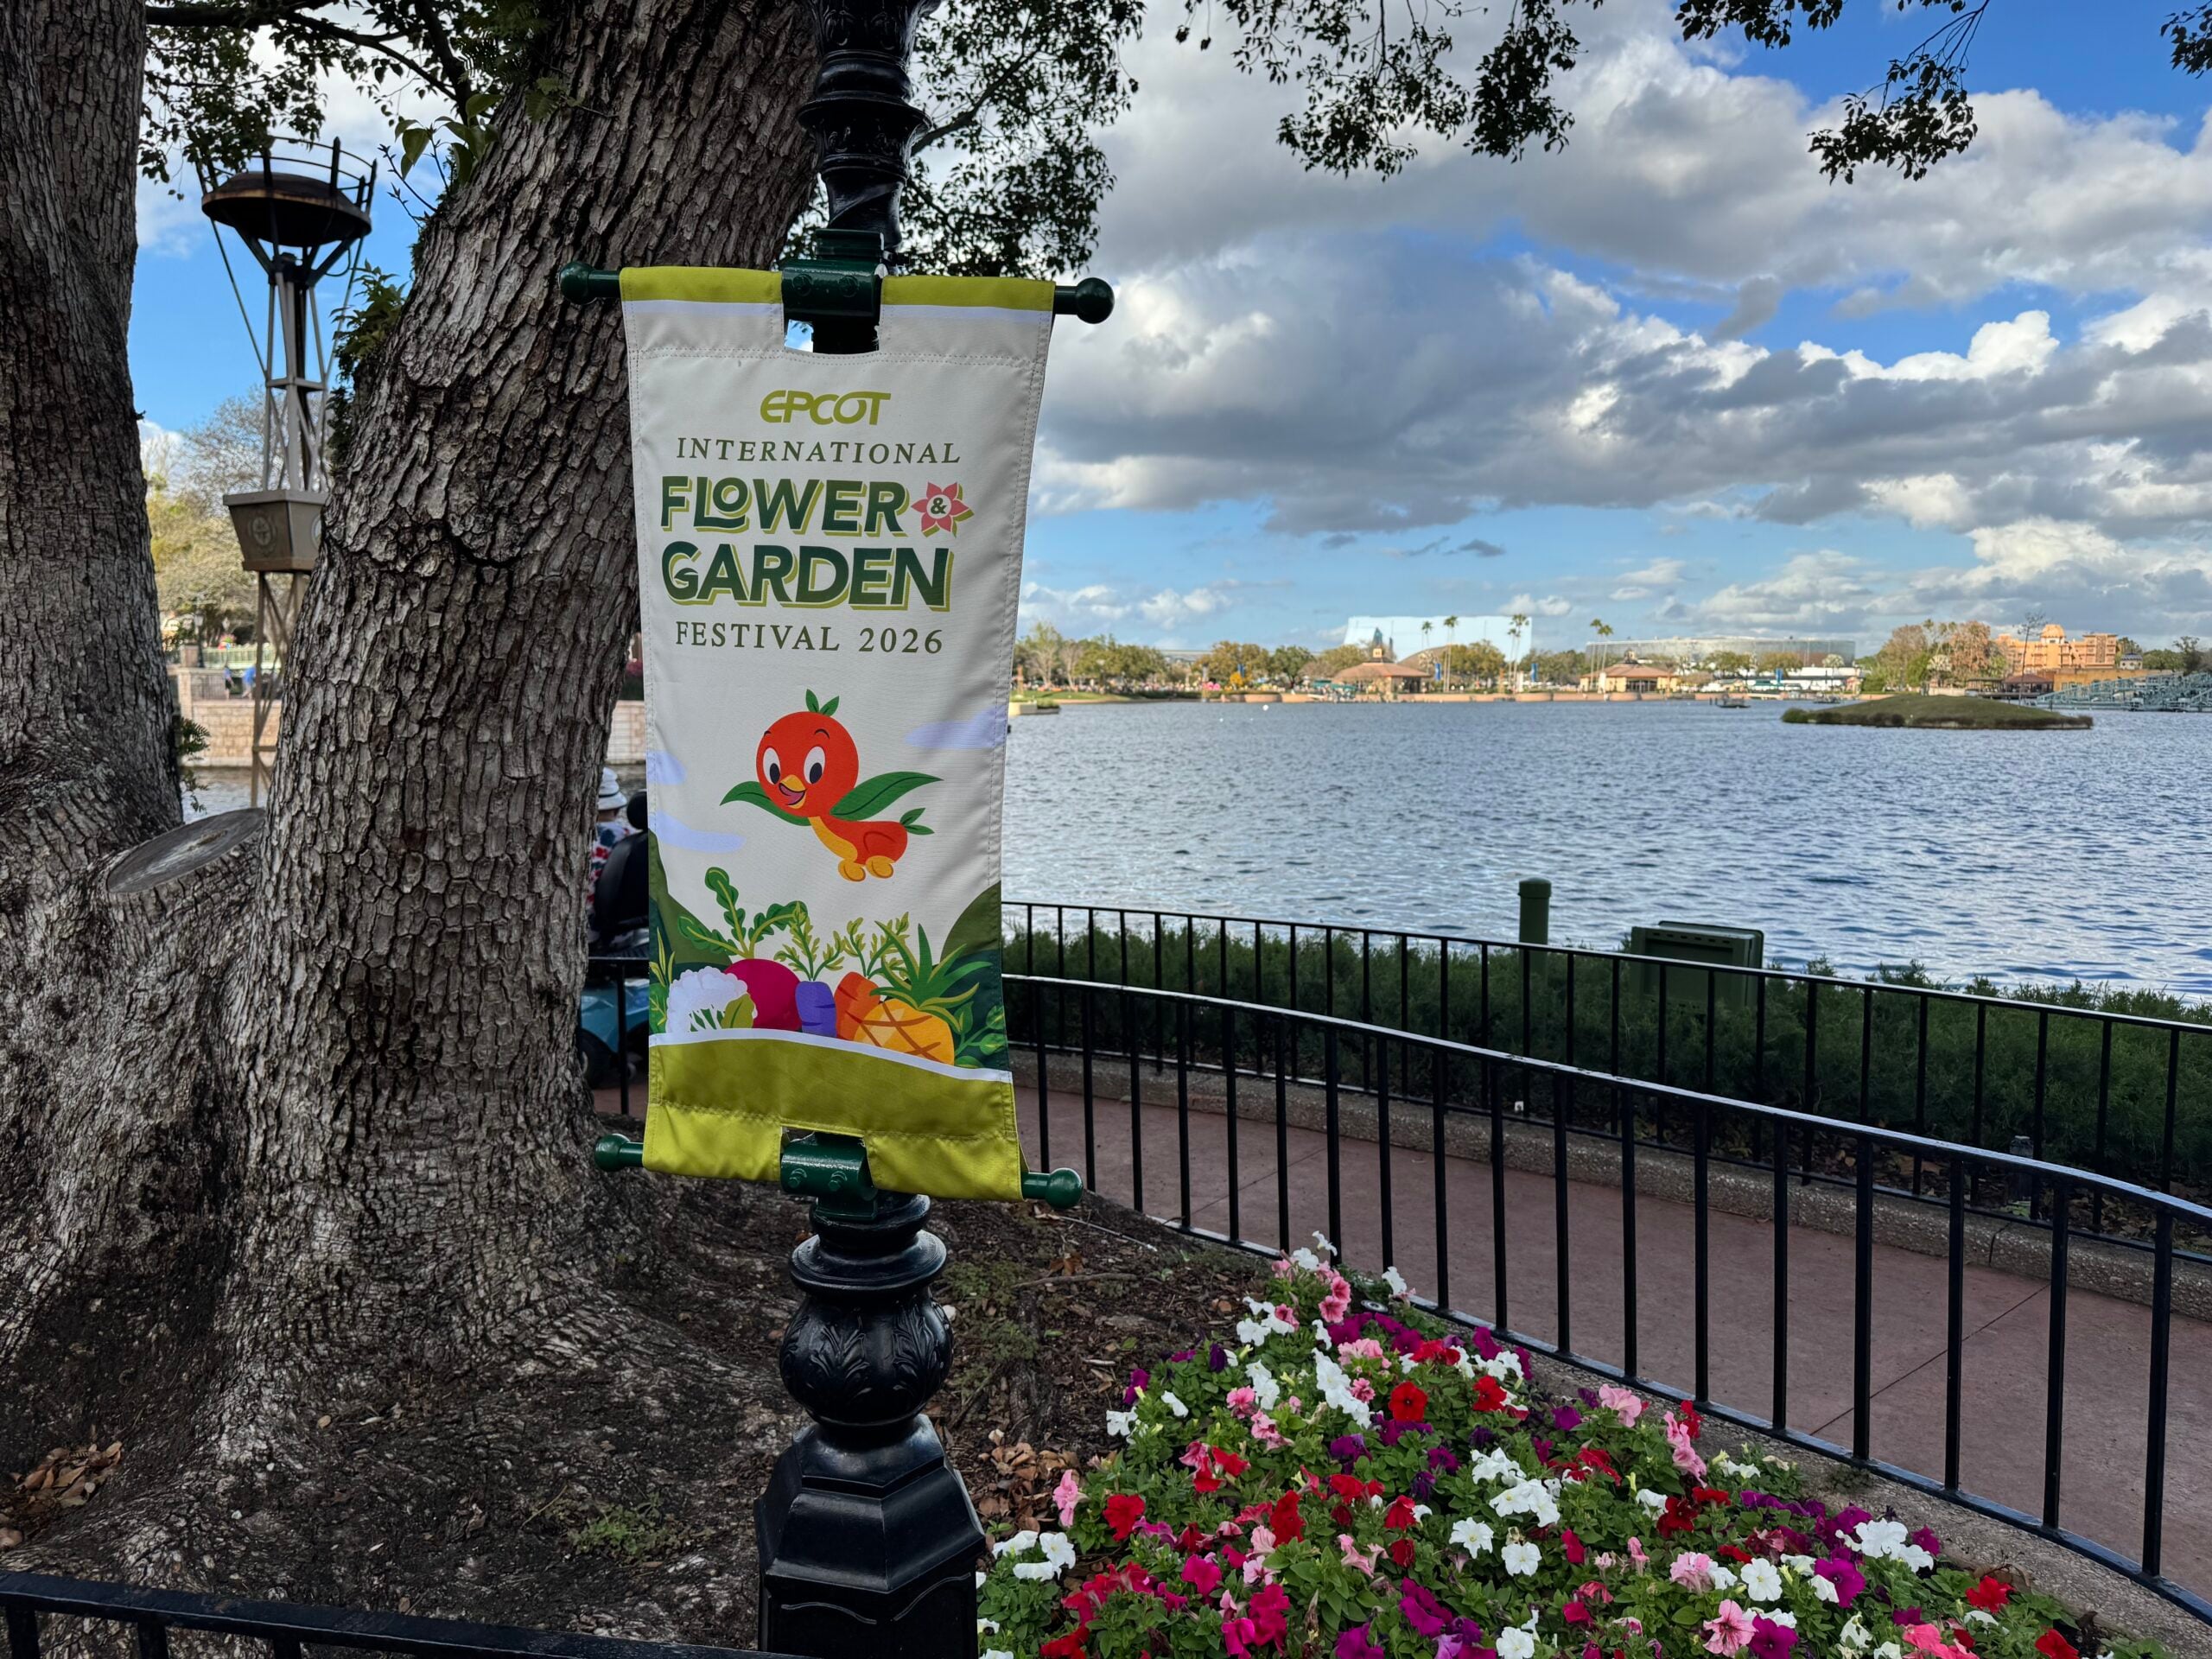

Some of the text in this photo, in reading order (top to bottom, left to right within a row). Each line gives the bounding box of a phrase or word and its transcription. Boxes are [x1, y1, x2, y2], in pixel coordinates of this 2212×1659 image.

[760, 390, 892, 425] EPCOT
[677, 437, 961, 464] INTERNATIONAL
[661, 476, 948, 537] FLOWER &
[661, 542, 954, 612] GARDEN
[676, 622, 943, 654] FESTIVAL 2026
